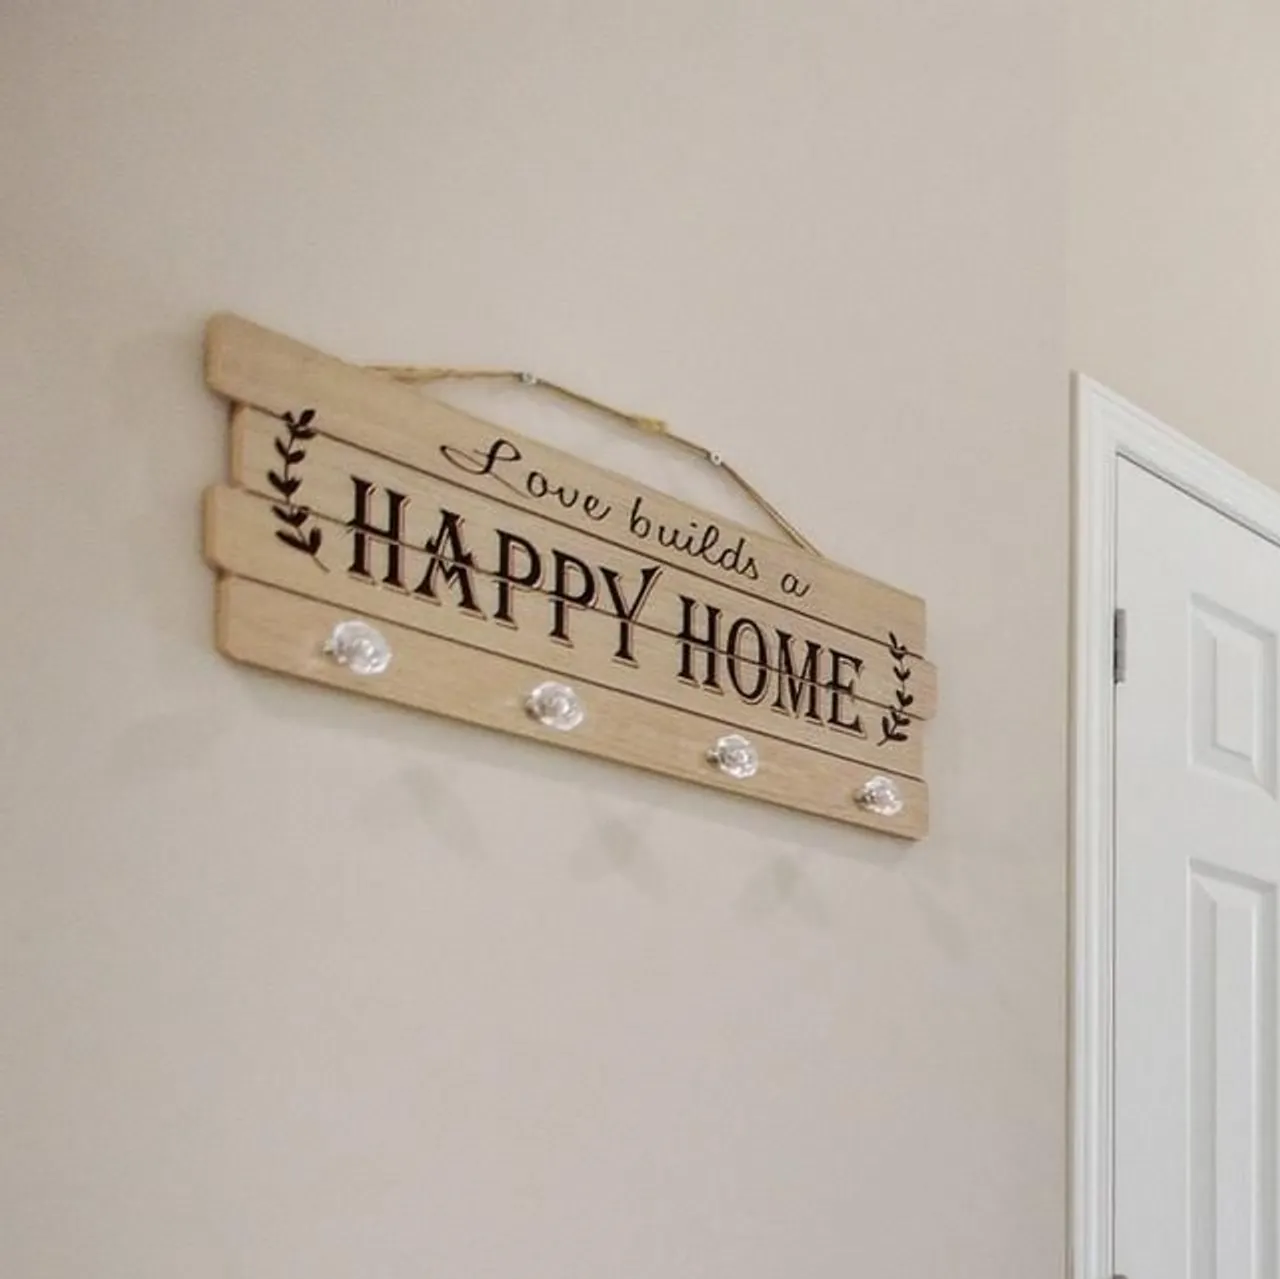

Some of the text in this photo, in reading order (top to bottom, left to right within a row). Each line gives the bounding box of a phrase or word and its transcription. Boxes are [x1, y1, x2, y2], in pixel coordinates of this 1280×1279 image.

[346, 475, 868, 737] HAPPY HOME
[440, 437, 811, 599] Love builds a
